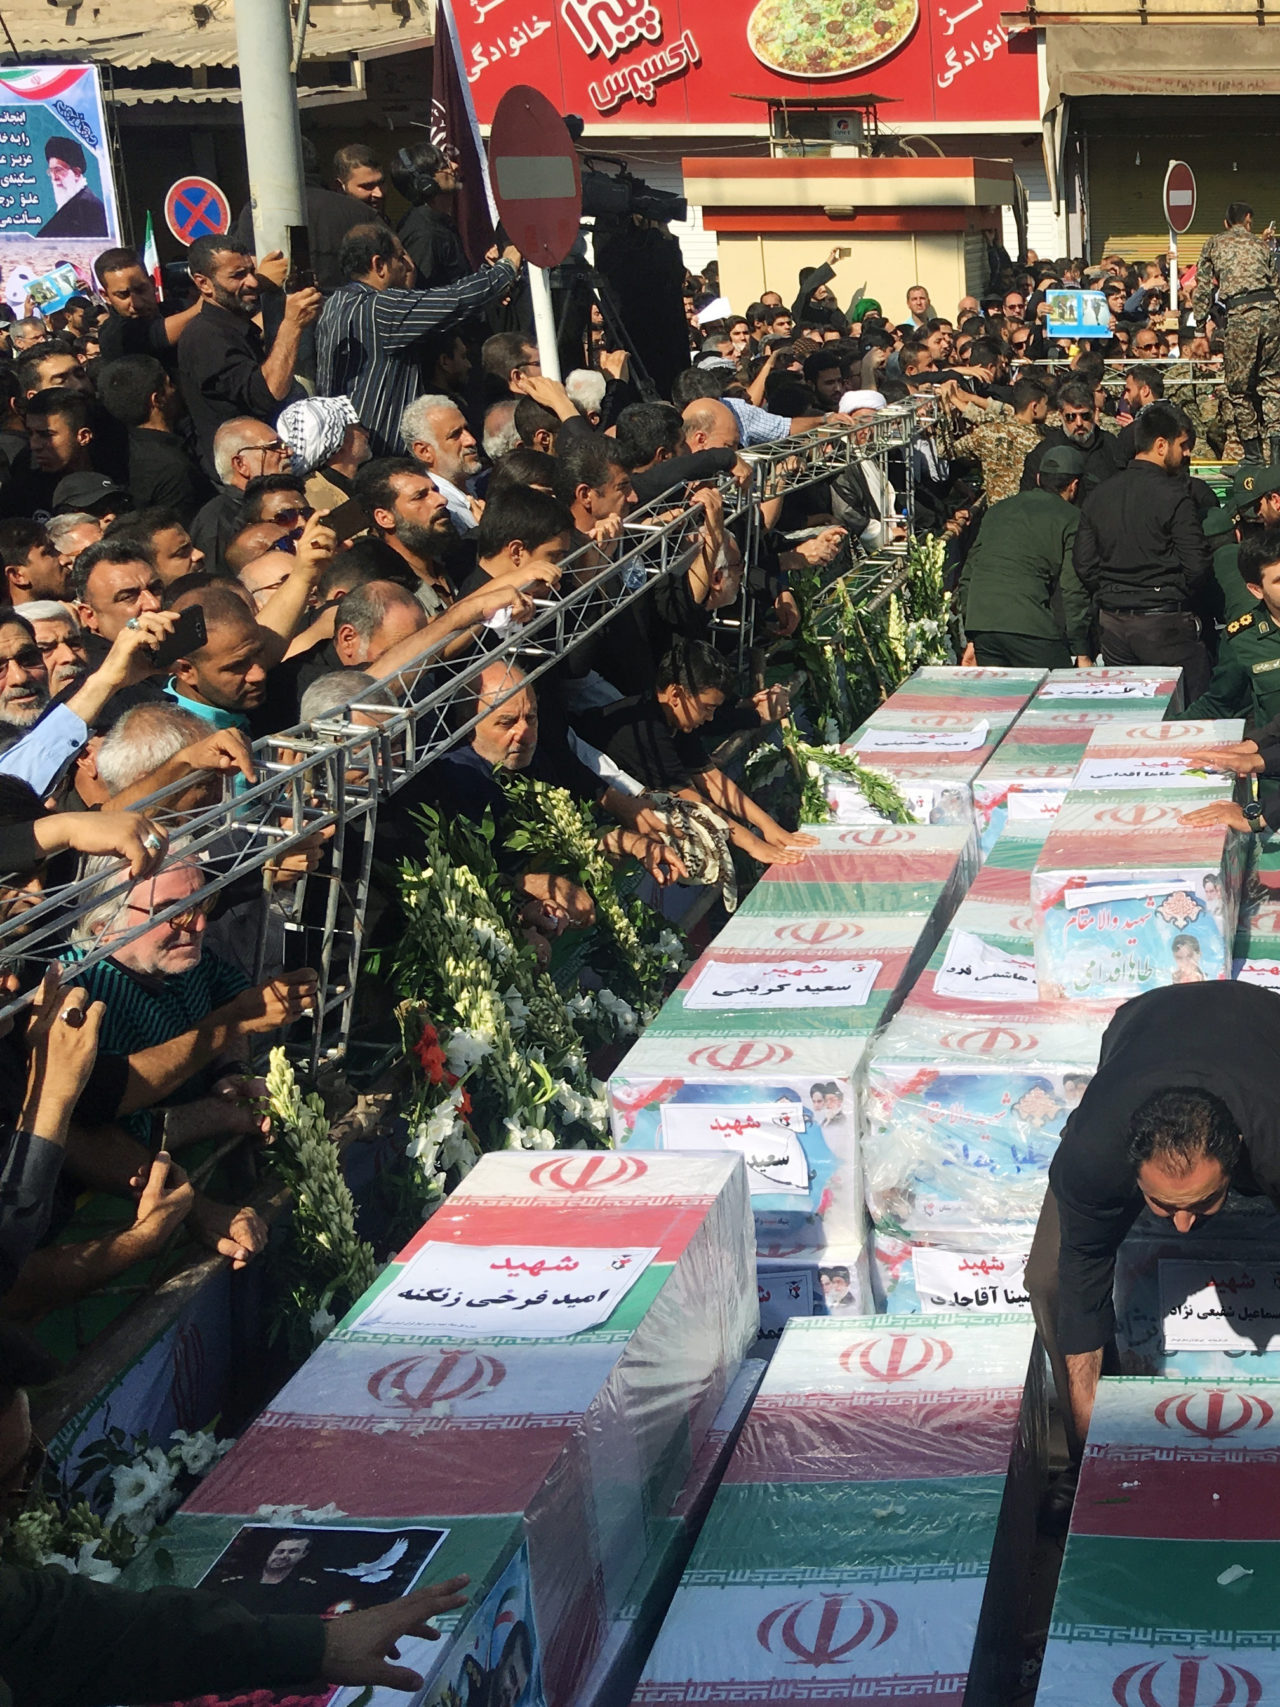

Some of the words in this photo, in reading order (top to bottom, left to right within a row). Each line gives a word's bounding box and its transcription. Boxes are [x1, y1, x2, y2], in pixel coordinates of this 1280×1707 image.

[466, 15, 552, 83] خانوادگی
[10, 155, 33, 167] عزیز
[762, 964, 829, 978] شهید
[711, 983, 792, 998] کریمی
[795, 983, 852, 995] سعید
[710, 1114, 762, 1138] شهید
[746, 1154, 790, 1172] سعید
[489, 1255, 580, 1278] شهید
[957, 1256, 1005, 1276] شهید
[1205, 1272, 1256, 1294] شهید
[396, 1287, 465, 1309] زنگنه
[465, 1289, 549, 1310] فرخی
[551, 1288, 611, 1309] امید
[1168, 1303, 1194, 1319] نژاد
[1196, 1304, 1236, 1321] شفیعی
